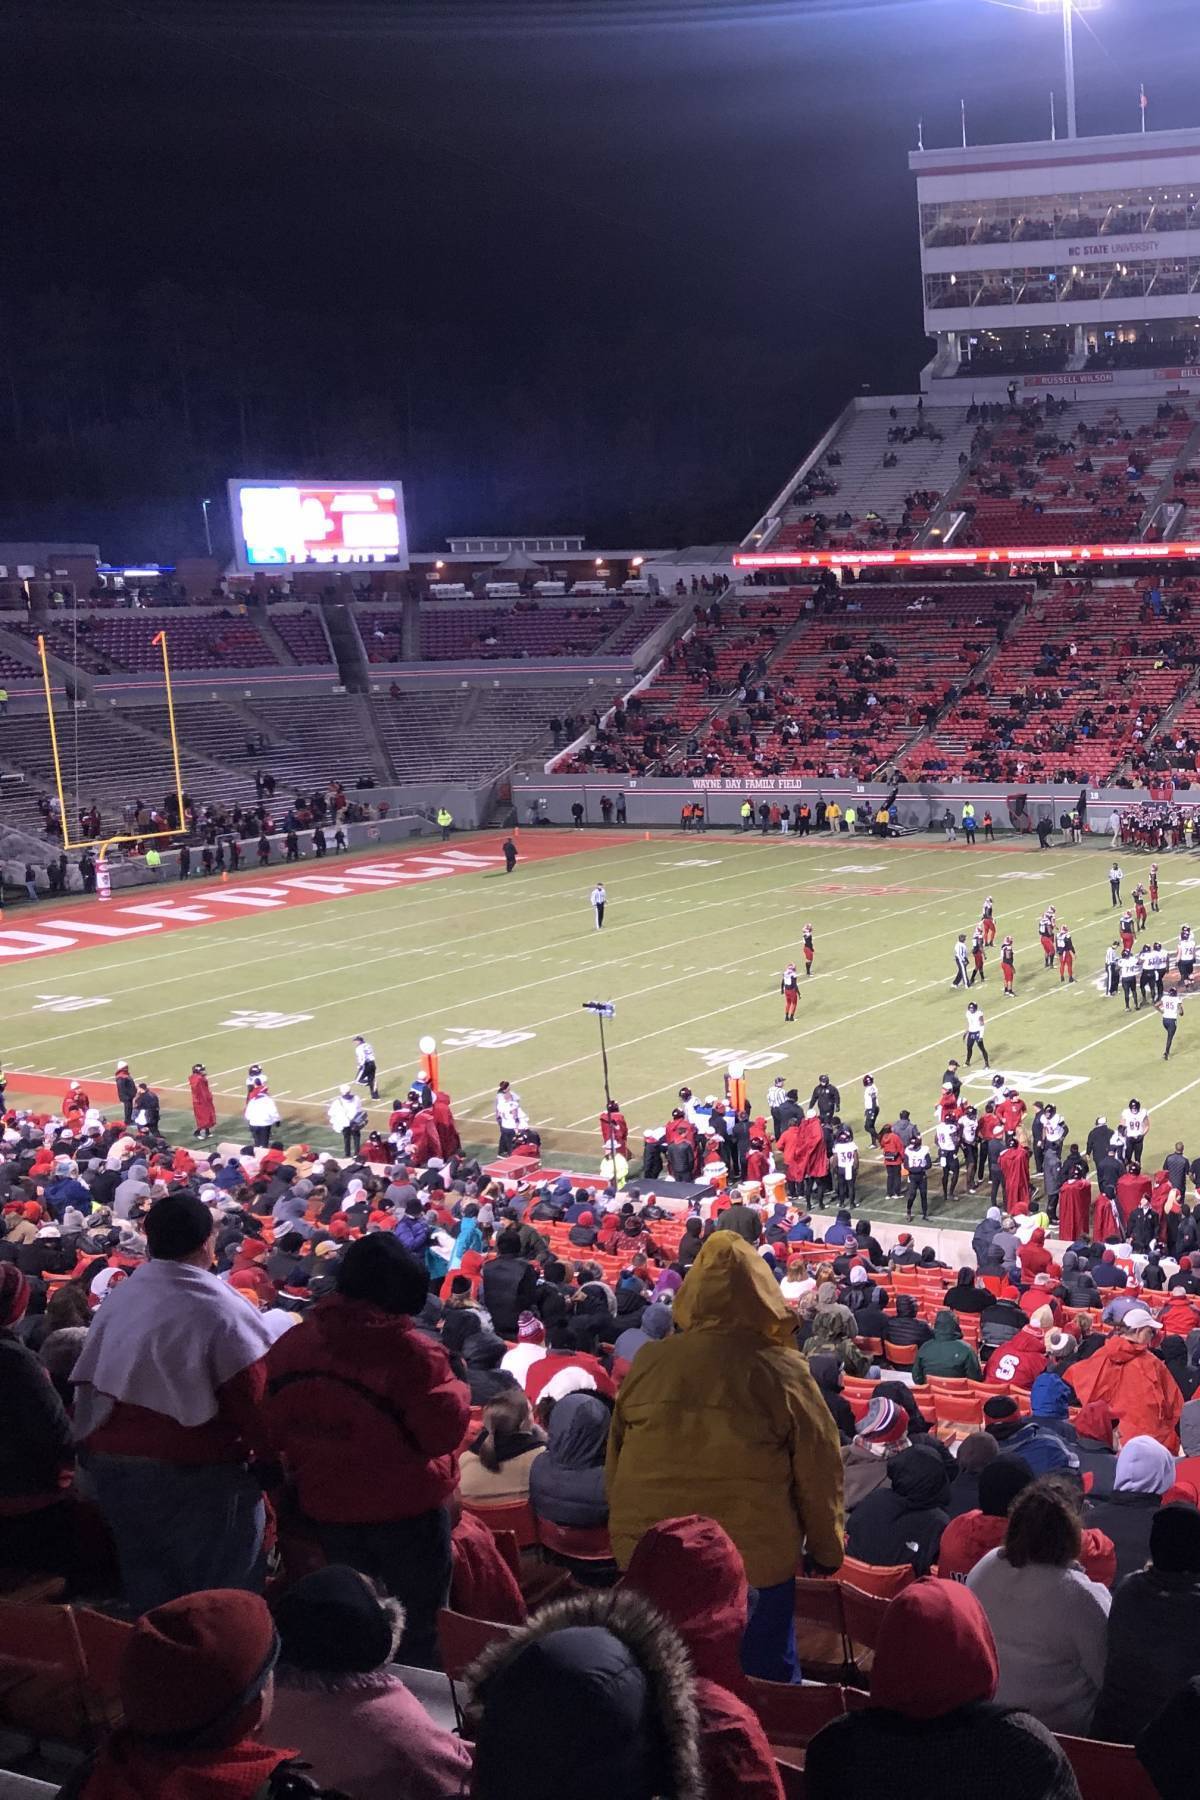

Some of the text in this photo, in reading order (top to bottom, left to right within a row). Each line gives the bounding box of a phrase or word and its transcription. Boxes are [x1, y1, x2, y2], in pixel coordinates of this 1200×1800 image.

[1068, 240, 1160, 256] NC STATE UNIVERSITY
[1040, 372, 1113, 384] RUSSELL WILSON
[692, 779, 802, 790] WAYNE DAY FAMILY FIELD
[1126, 1119, 1140, 1131] 89
[994, 1353, 1020, 1382] S
